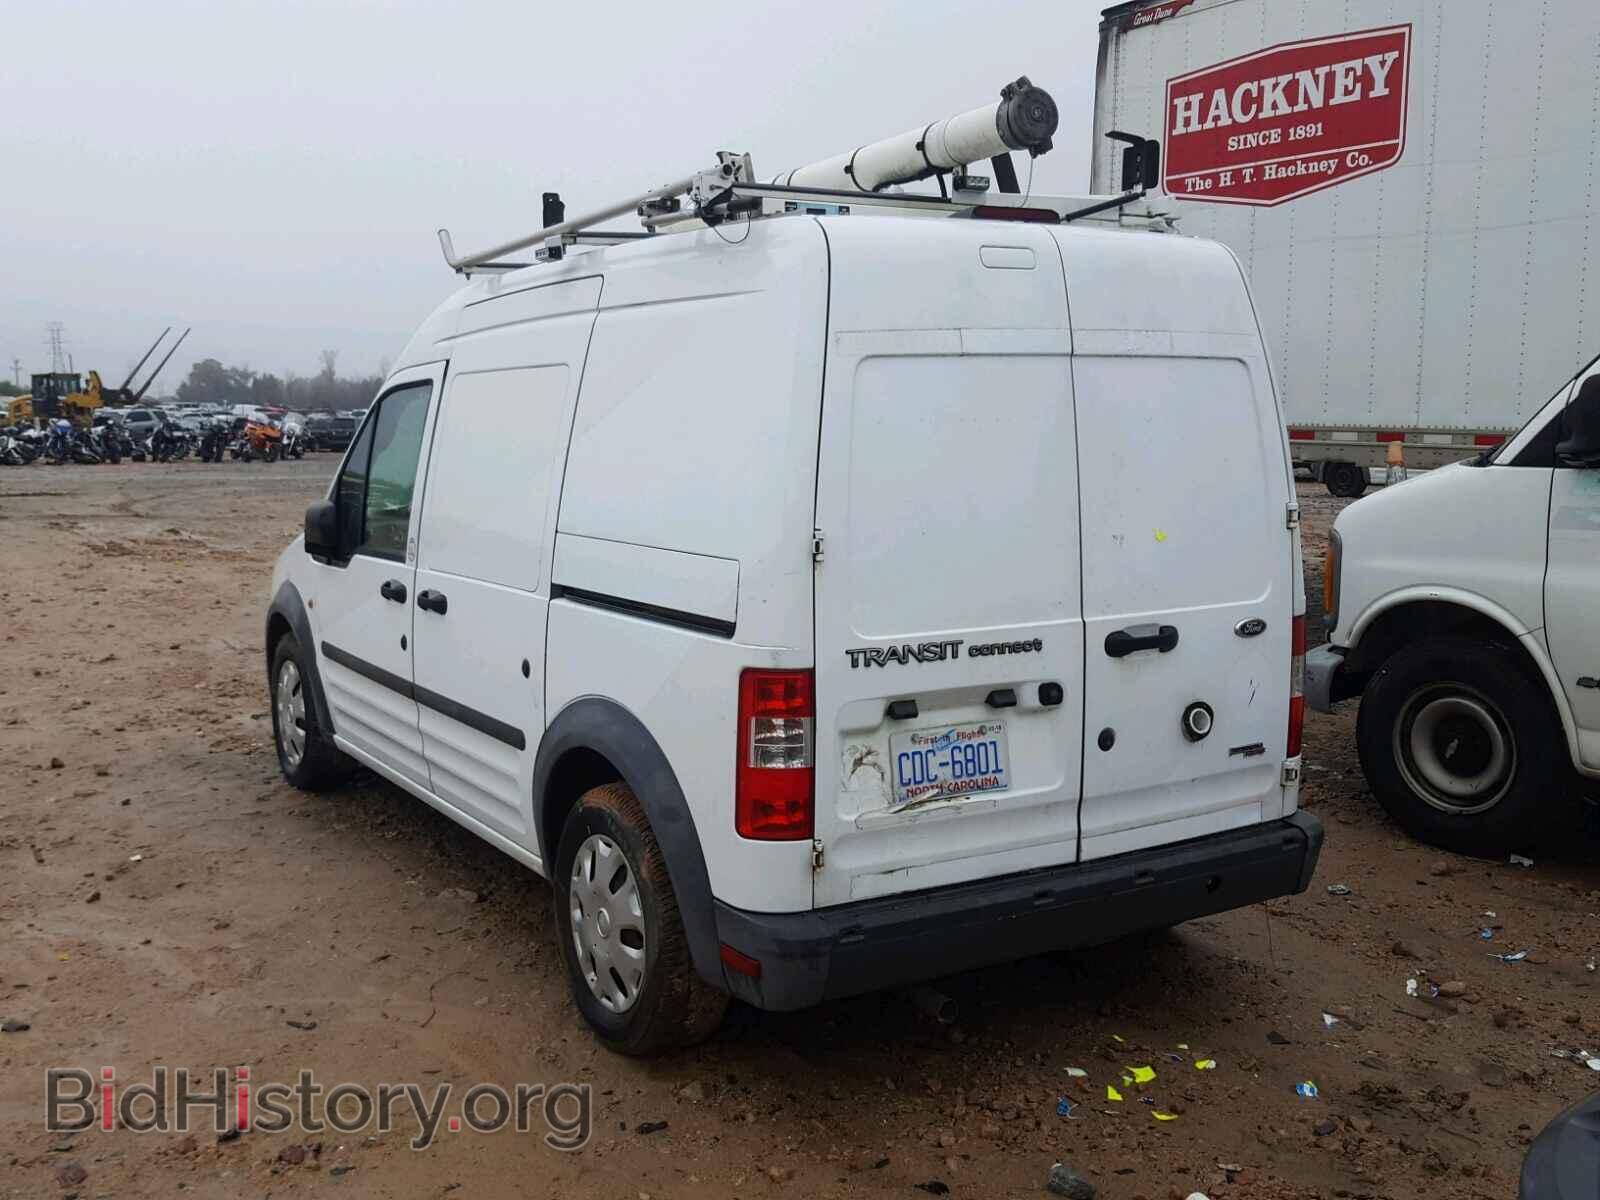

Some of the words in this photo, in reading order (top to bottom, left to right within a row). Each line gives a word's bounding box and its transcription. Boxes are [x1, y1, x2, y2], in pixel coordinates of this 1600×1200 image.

[1172, 51, 1398, 135] HACKNEY
[1227, 128, 1281, 151] SINCE
[1288, 122, 1324, 141] 1891
[1184, 178, 1213, 192] The
[1219, 172, 1236, 187] H.
[1243, 168, 1257, 183] T.
[1264, 158, 1338, 181] Hackney
[1346, 152, 1373, 168] Co.
[845, 640, 964, 668] TRANSIT
[968, 638, 1042, 657] connect
[898, 741, 1003, 786] CDC-6801
[947, 776, 999, 793] CAROLINA
